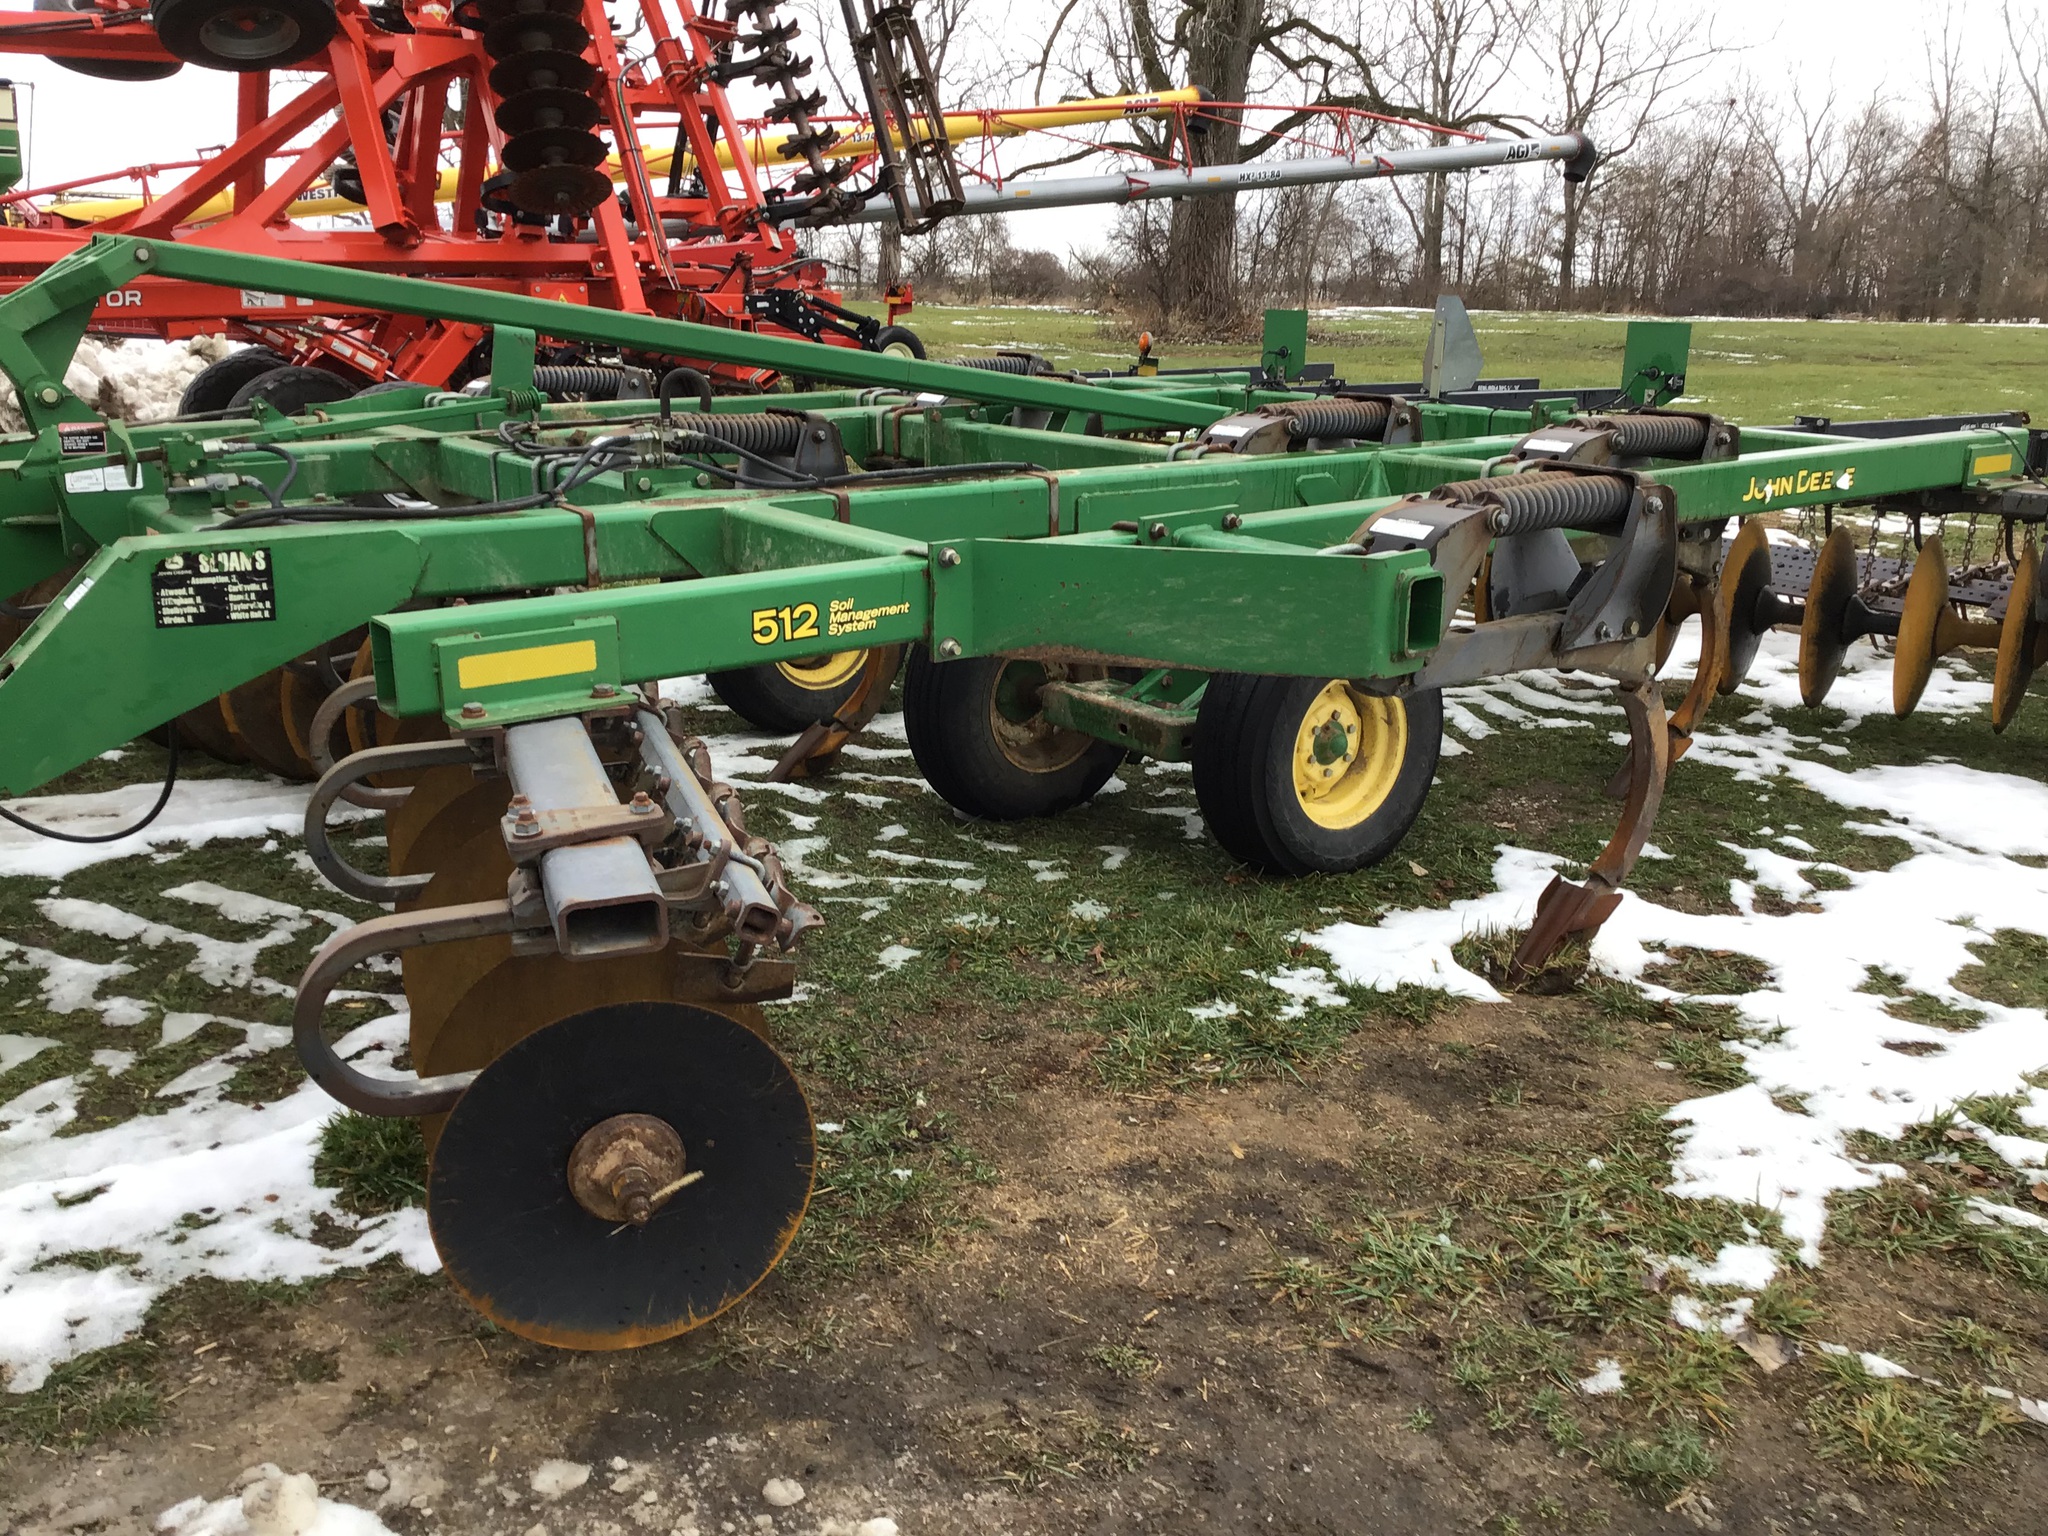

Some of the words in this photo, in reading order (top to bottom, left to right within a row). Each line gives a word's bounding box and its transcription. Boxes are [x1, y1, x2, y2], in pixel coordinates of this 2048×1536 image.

[1506, 144, 1530, 160] AGI
[297, 188, 338, 201] WEST
[1796, 467, 1856, 494] DEEE
[829, 598, 854, 612] Soil
[829, 602, 911, 624] Management
[752, 602, 820, 645] 512
[828, 619, 877, 636] System
